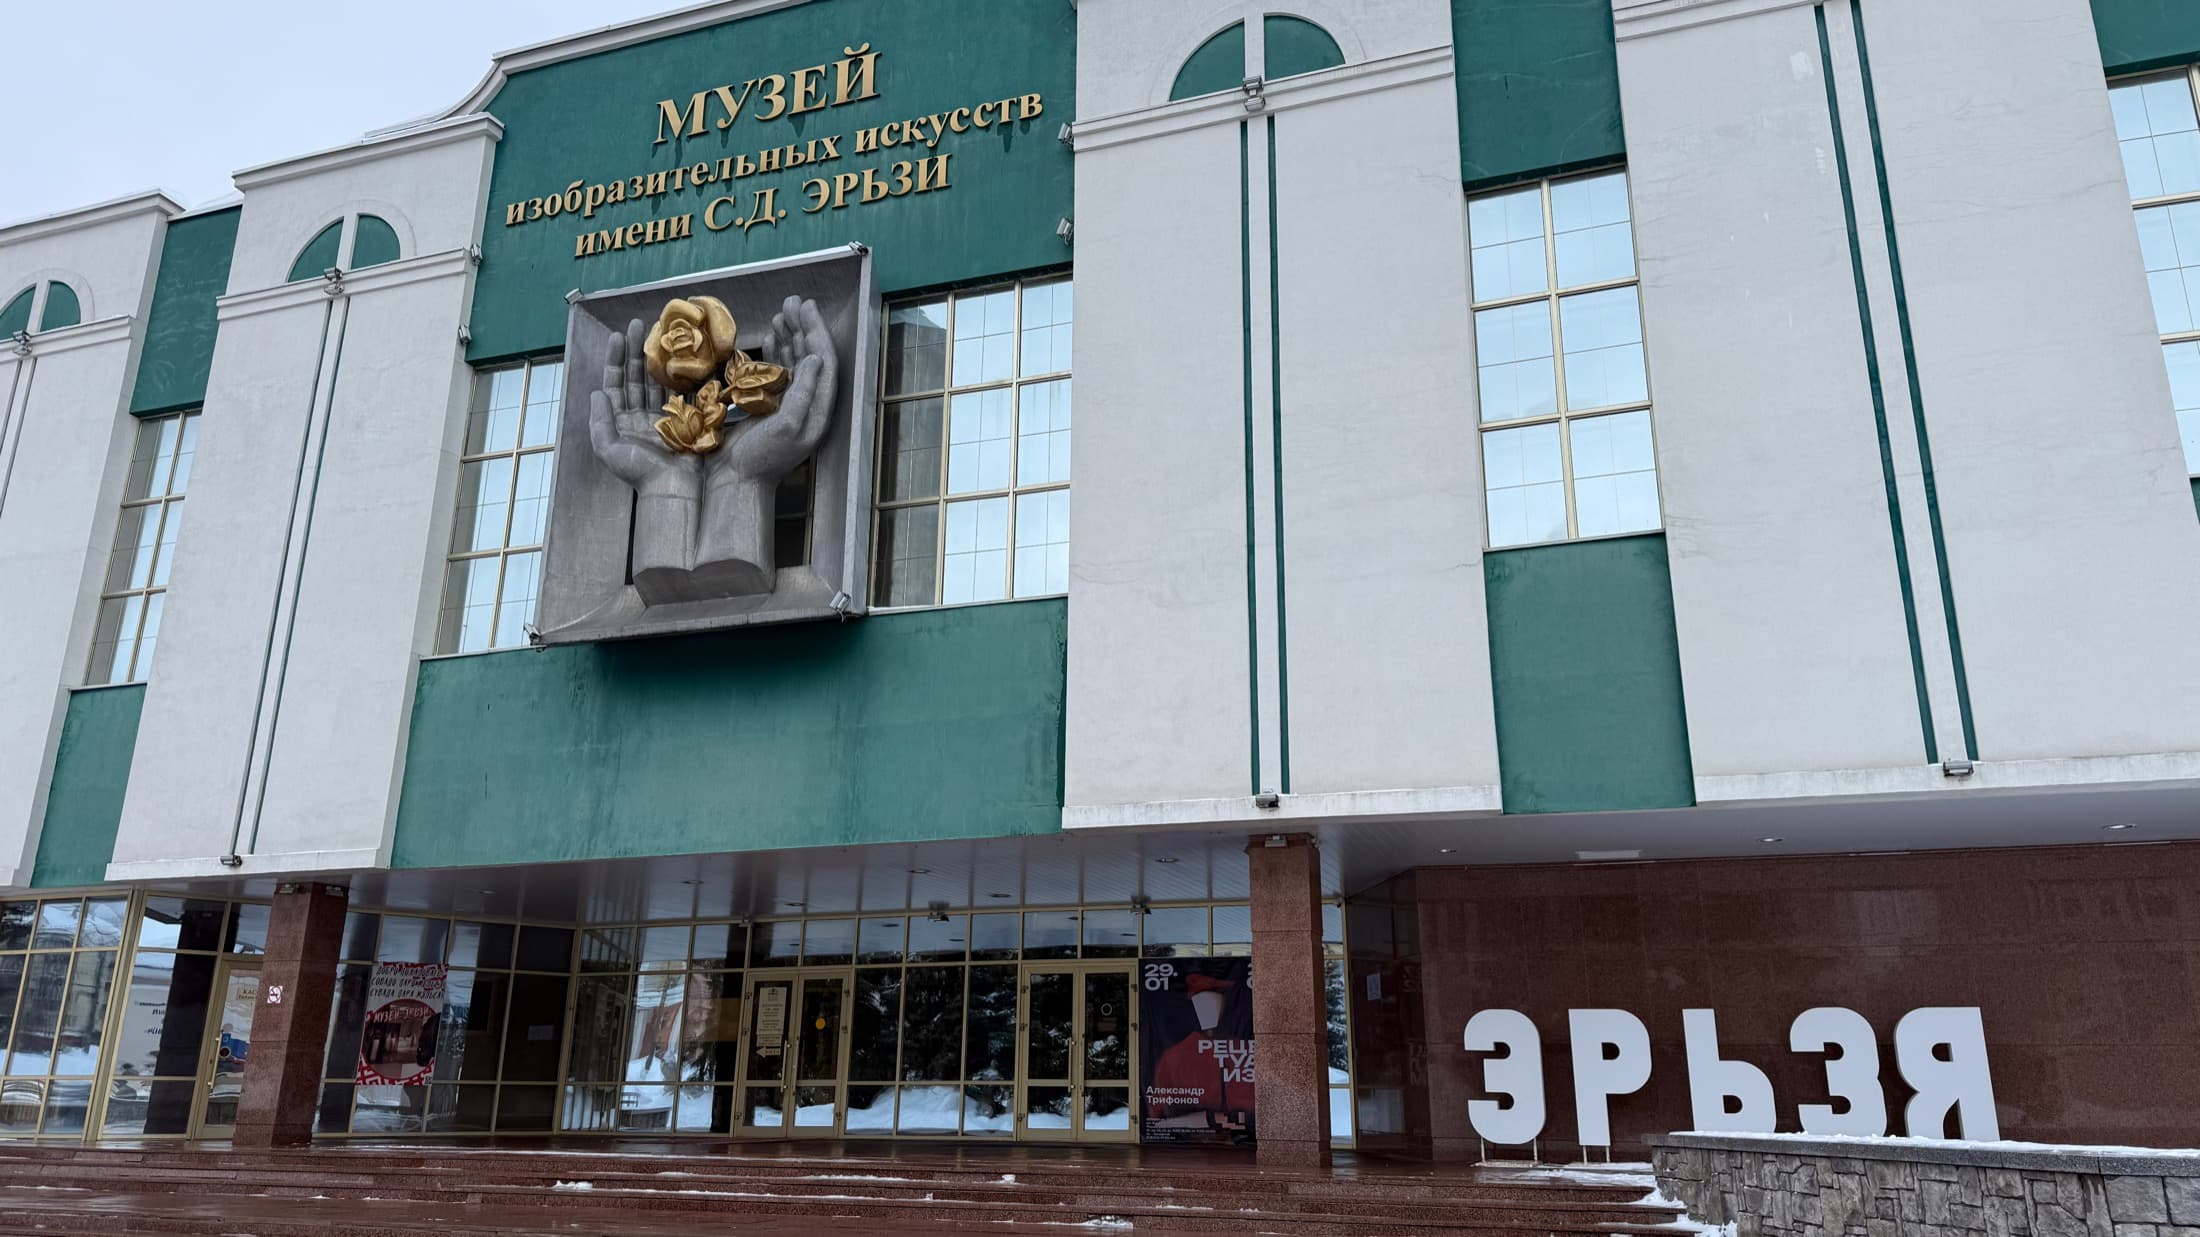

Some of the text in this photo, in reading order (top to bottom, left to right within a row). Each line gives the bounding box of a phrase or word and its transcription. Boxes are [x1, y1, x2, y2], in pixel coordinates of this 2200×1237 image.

[653, 43, 881, 144] МУЗЕЙ
[505, 93, 1043, 226] изобразительных искусств
[574, 153, 952, 258] имени С.Д. ЭРЬЗИ
[1144, 963, 1178, 977] 29.
[1144, 977, 1169, 991] 01
[1145, 1085, 1205, 1097] Александр
[1146, 1095, 1200, 1106] Трифонов
[1464, 1006, 2000, 1146] ЭРЬЗЯ
